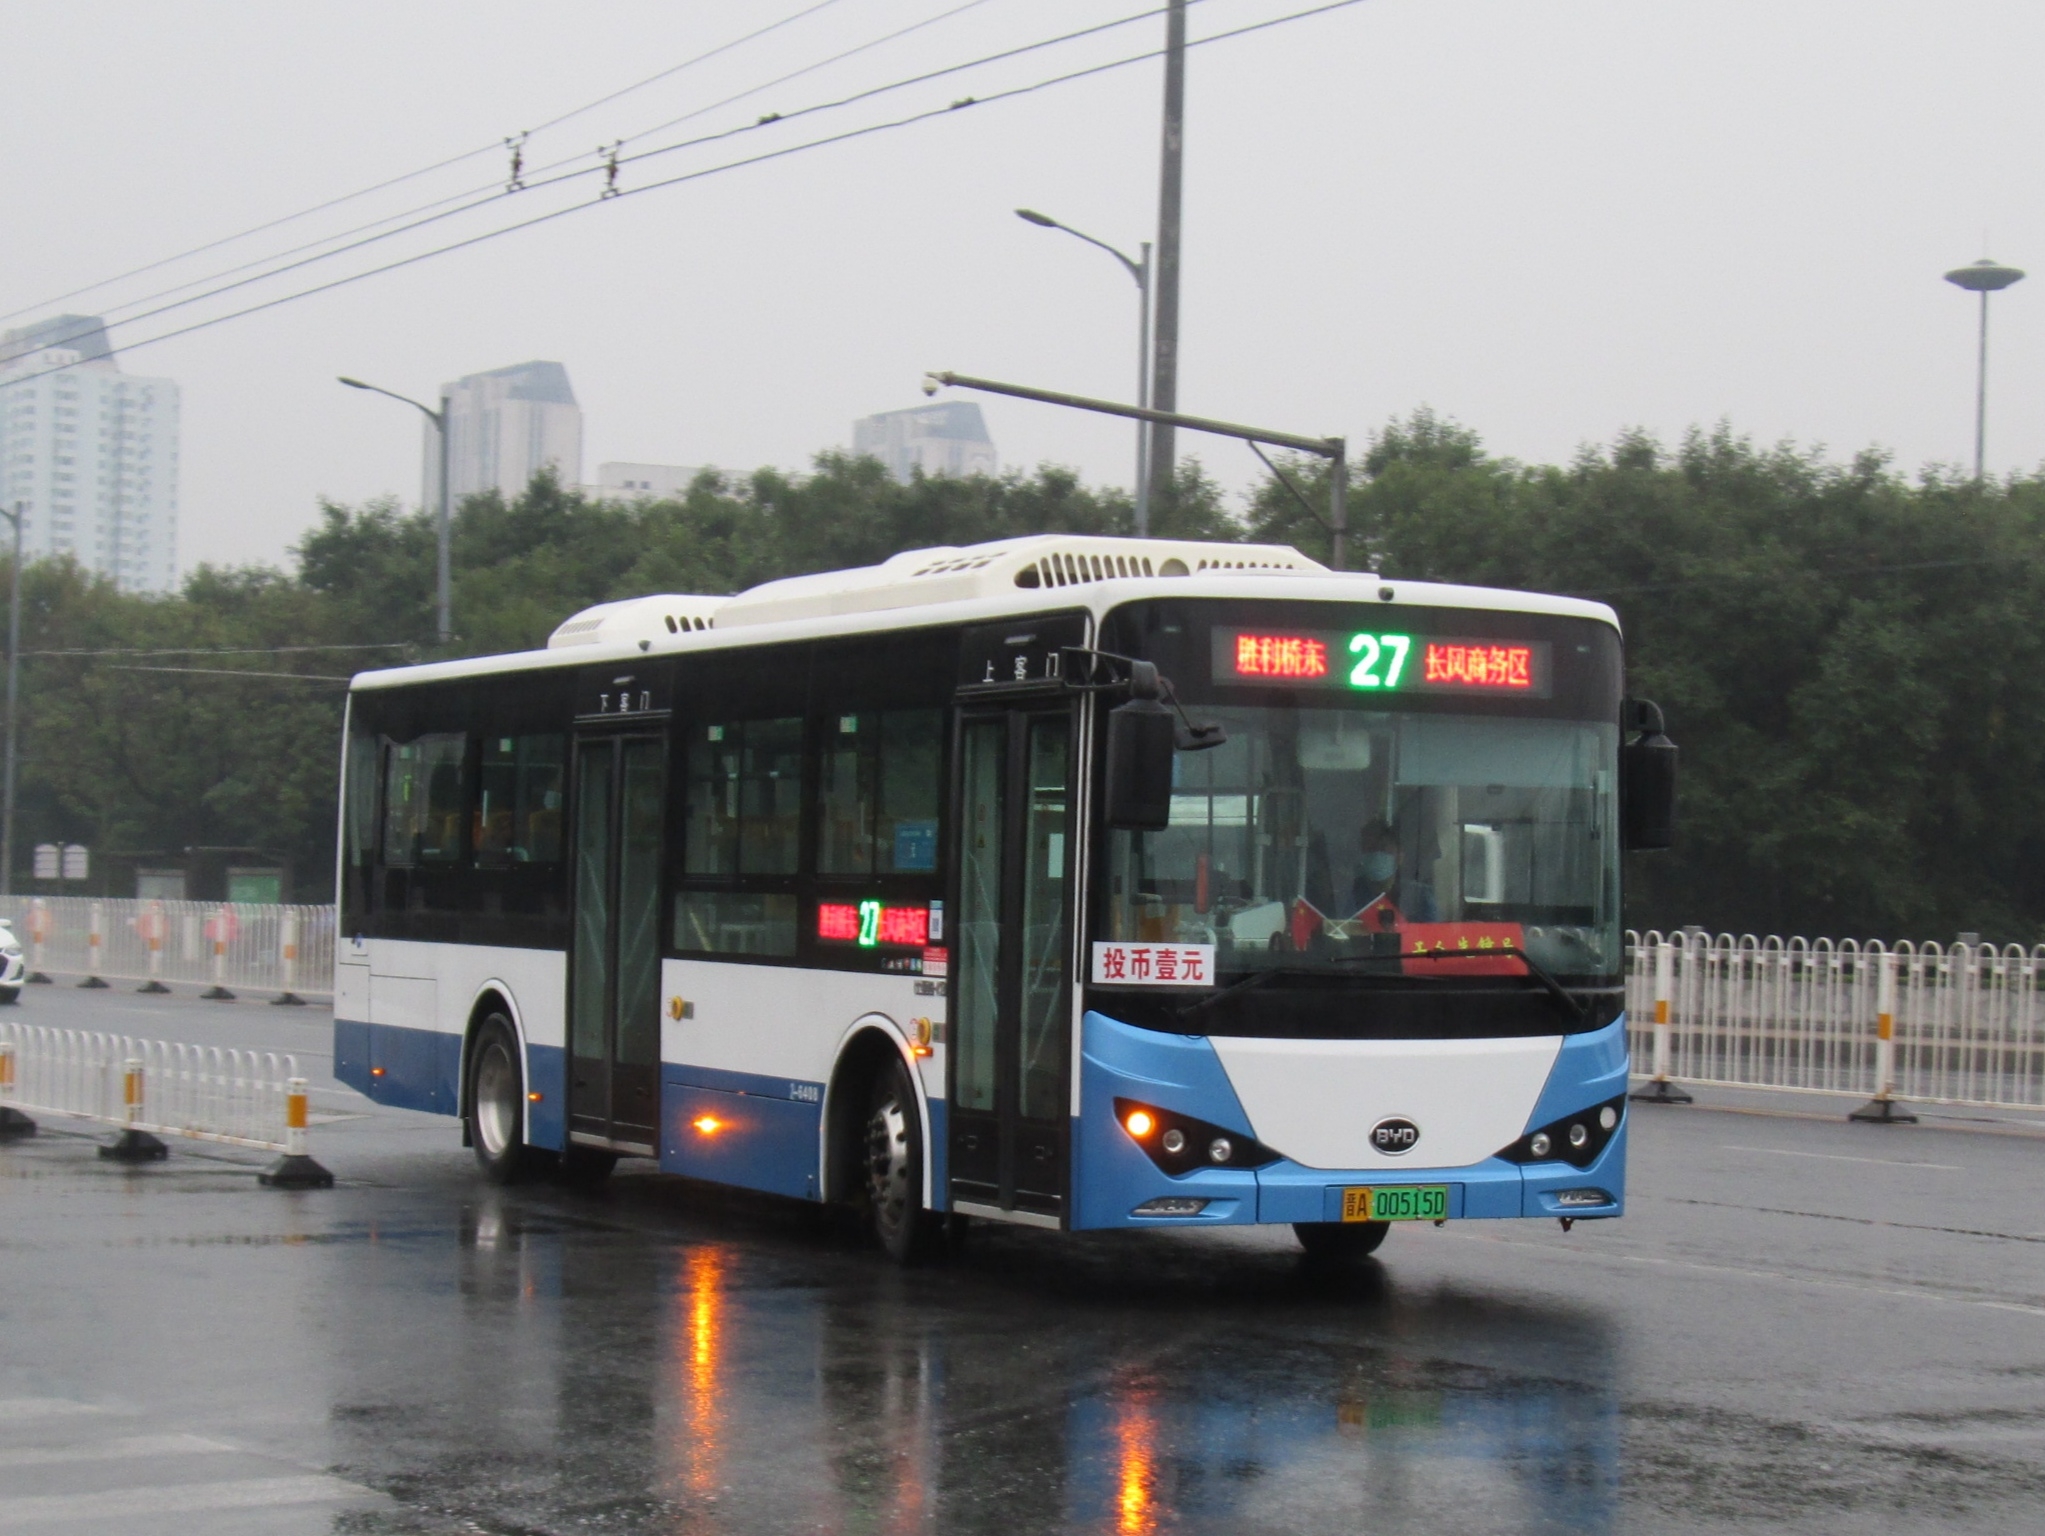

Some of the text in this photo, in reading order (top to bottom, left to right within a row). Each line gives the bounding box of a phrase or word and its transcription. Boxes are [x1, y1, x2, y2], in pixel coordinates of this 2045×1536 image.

[1237, 634, 1530, 687] 胜利桥东 27 长风商务区
[859, 901, 879, 945] 27
[1104, 947, 1203, 980] 投币壹元
[1376, 1128, 1415, 1144] BYD
